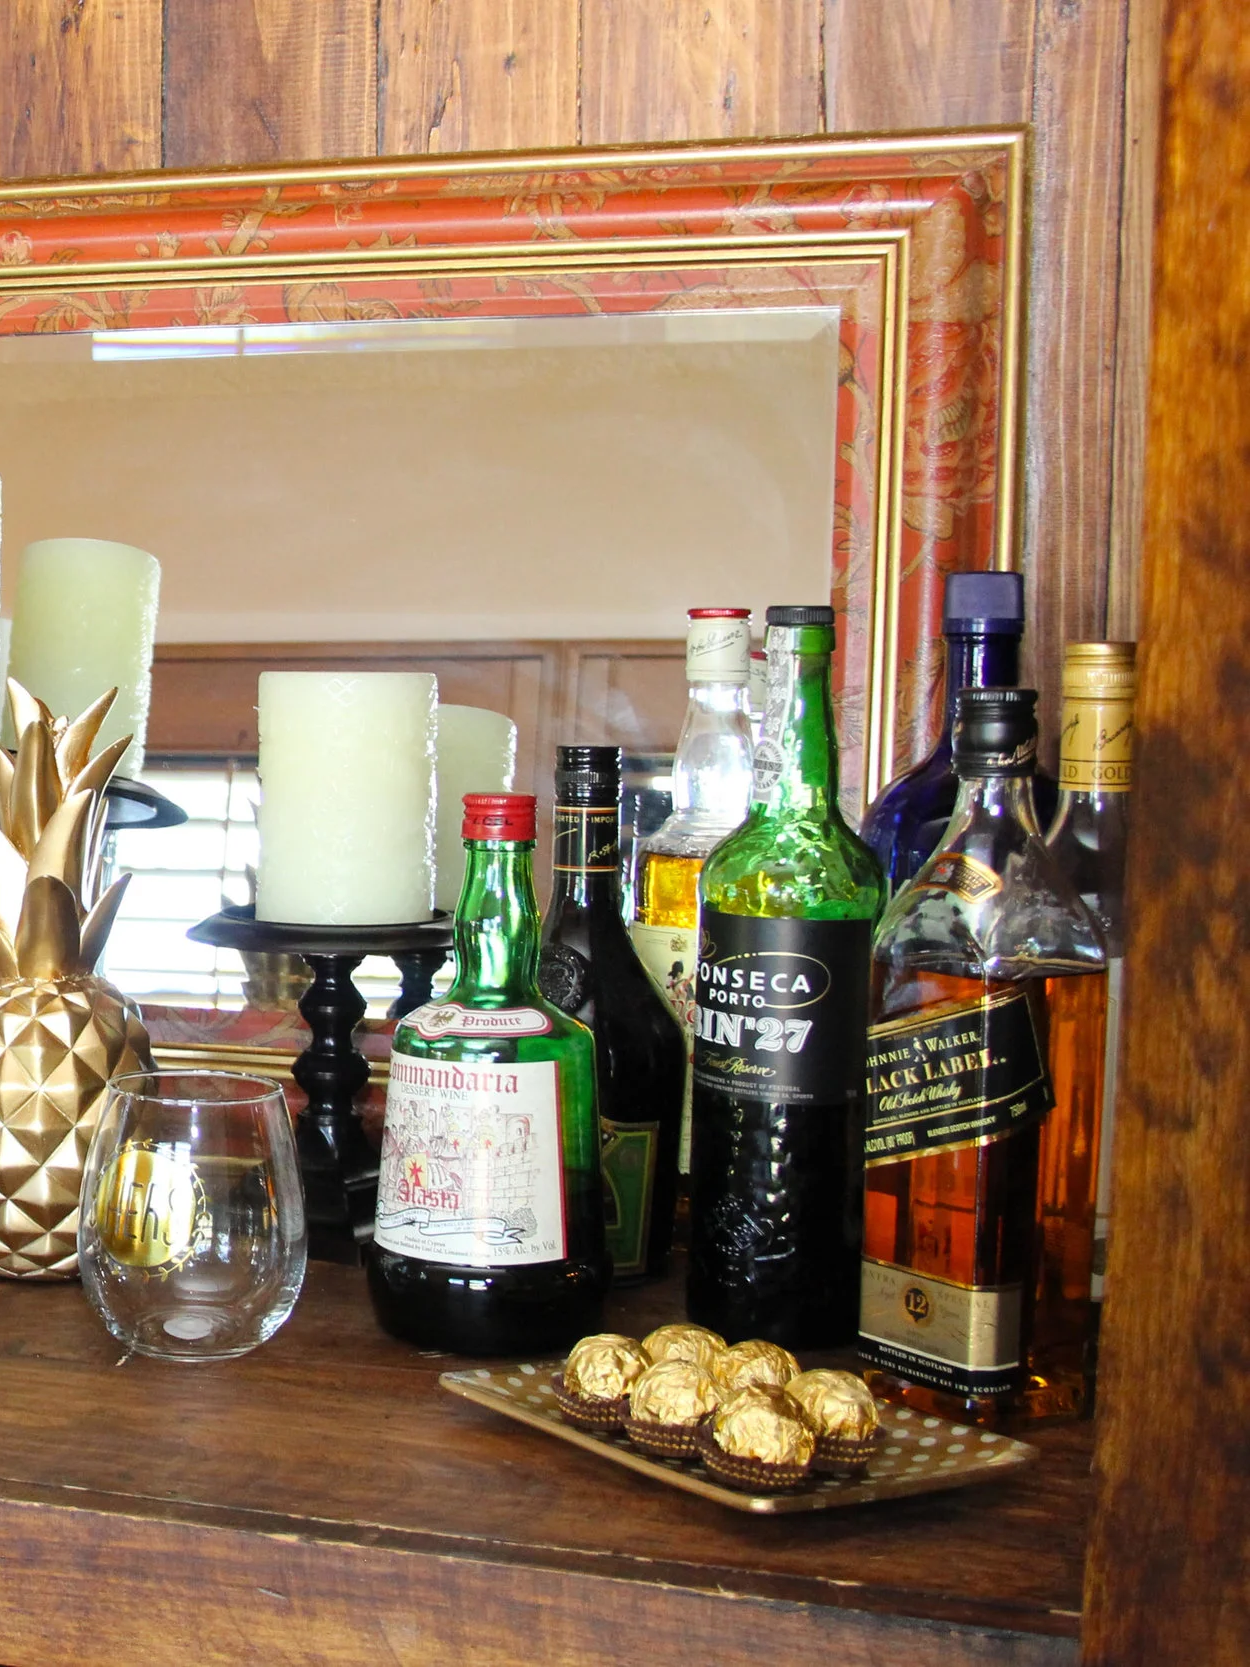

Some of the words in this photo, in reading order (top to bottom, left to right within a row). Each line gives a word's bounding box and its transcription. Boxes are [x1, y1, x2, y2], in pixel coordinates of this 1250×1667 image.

[1062, 765, 1078, 779] LD
[556, 814, 580, 824] ORTED
[590, 815, 614, 824] IMPOR
[695, 962, 811, 994] ONSECA
[709, 988, 765, 1009] PORTO
[461, 1013, 521, 1027] Produce
[754, 1016, 814, 1054] 27
[724, 1056, 777, 1077] Reserve
[865, 1047, 911, 1069] HNNIE
[389, 1059, 519, 1095] ommandaria
[865, 1065, 921, 1095] LACK
[922, 1048, 991, 1081] LABEL
[400, 1083, 436, 1098] DESSERT
[439, 1087, 468, 1101] WINE
[878, 1091, 898, 1112] Old
[897, 1085, 927, 1110] Scotch
[926, 1080, 963, 1102] Whisky
[493, 1246, 510, 1258] 15%
[531, 1244, 540, 1255] by
[907, 1291, 928, 1315] 12
[878, 1345, 907, 1360] BOTTLED
[918, 1357, 953, 1374] SCOTLAND
